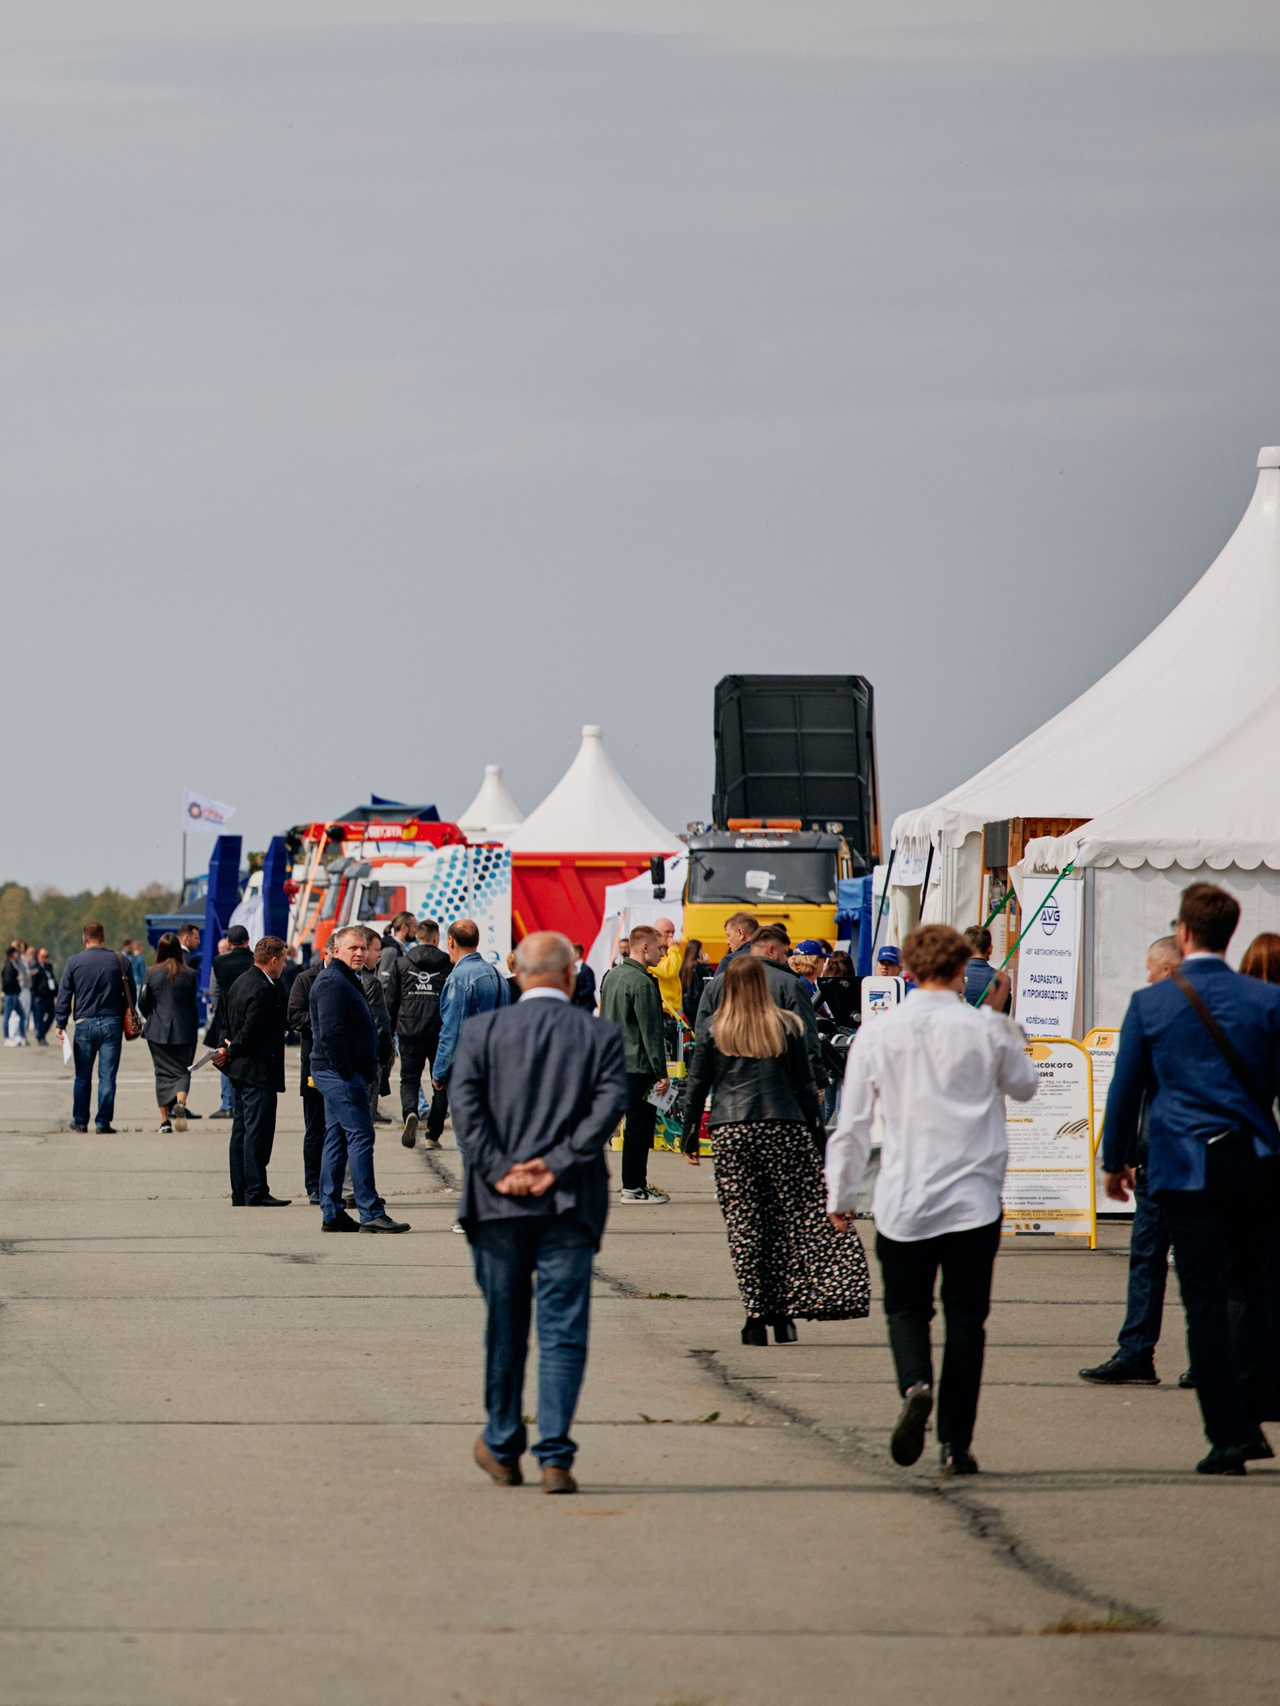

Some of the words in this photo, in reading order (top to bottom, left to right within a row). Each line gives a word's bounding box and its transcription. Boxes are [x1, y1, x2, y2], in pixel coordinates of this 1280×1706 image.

[1040, 910, 1060, 921] AVG
[1030, 974, 1062, 984] РАЗРАБОТКА
[1027, 989, 1068, 1001] ПРОИЗВОДСТВО
